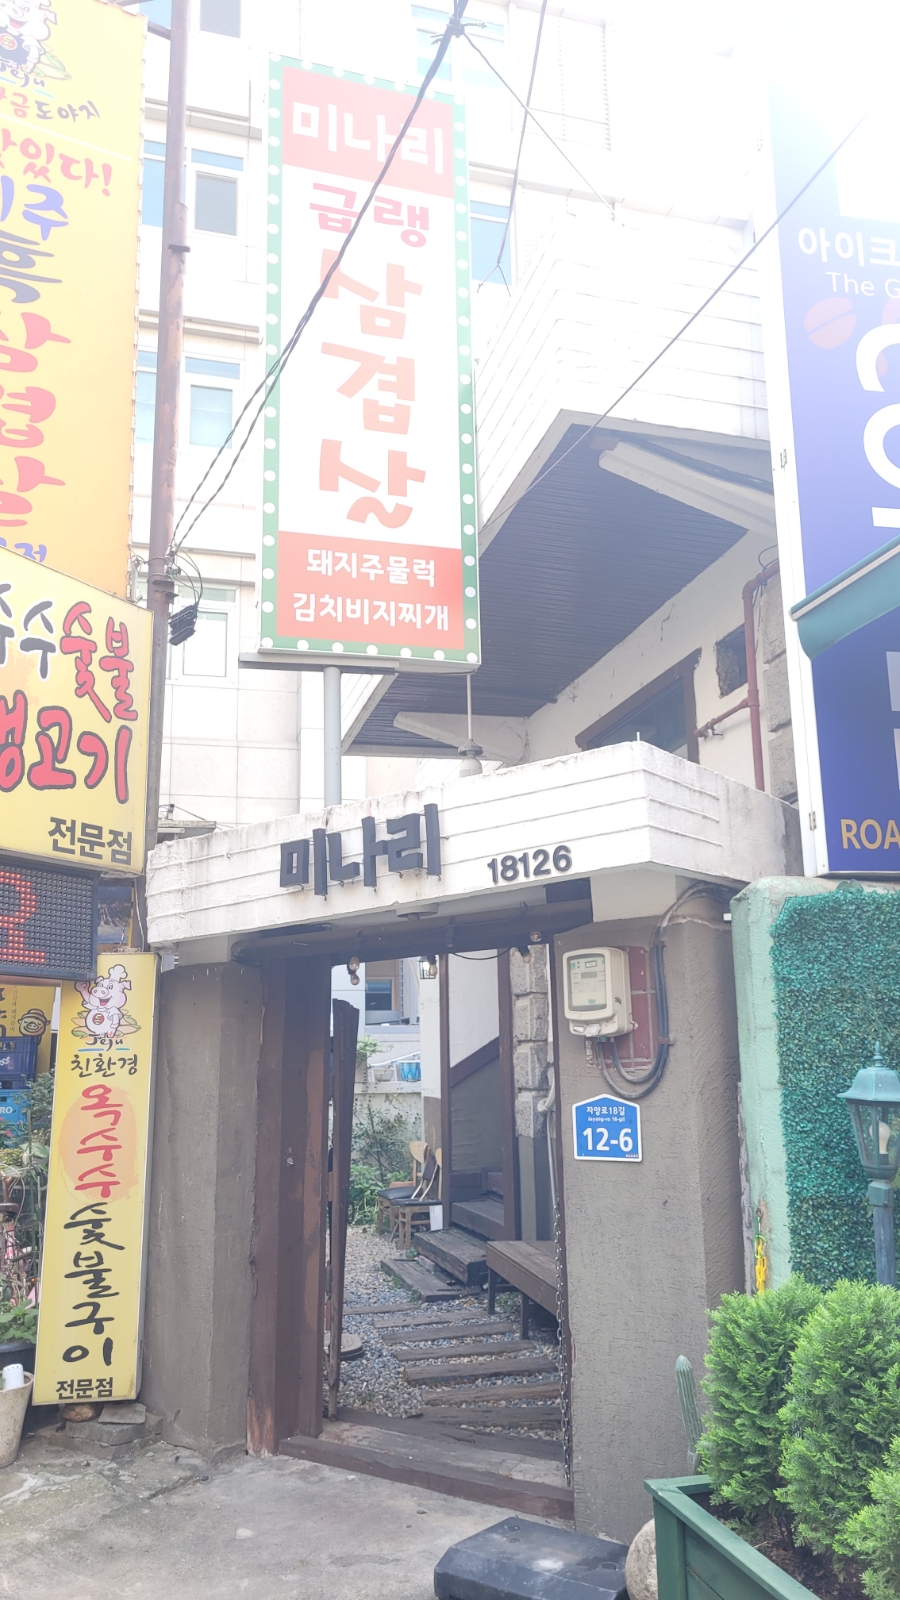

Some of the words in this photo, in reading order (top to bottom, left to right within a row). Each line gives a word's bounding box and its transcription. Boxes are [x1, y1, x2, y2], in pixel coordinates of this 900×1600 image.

[292, 101, 444, 175] 미나리
[309, 182, 430, 248] 급랭
[825, 271, 875, 297] The
[318, 248, 427, 529] 삼겹살
[306, 548, 436, 588] 돼지주물럭
[47, 816, 134, 867] 전문점
[279, 803, 442, 896] 미나리
[486, 845, 573, 884] 18126
[70, 1053, 138, 1078] 친환경
[586, 1106, 626, 1116] 자양로18길
[74, 1084, 124, 1199] 옥수수
[582, 1127, 633, 1152] 12-6
[55, 1376, 114, 1400] 전문점
